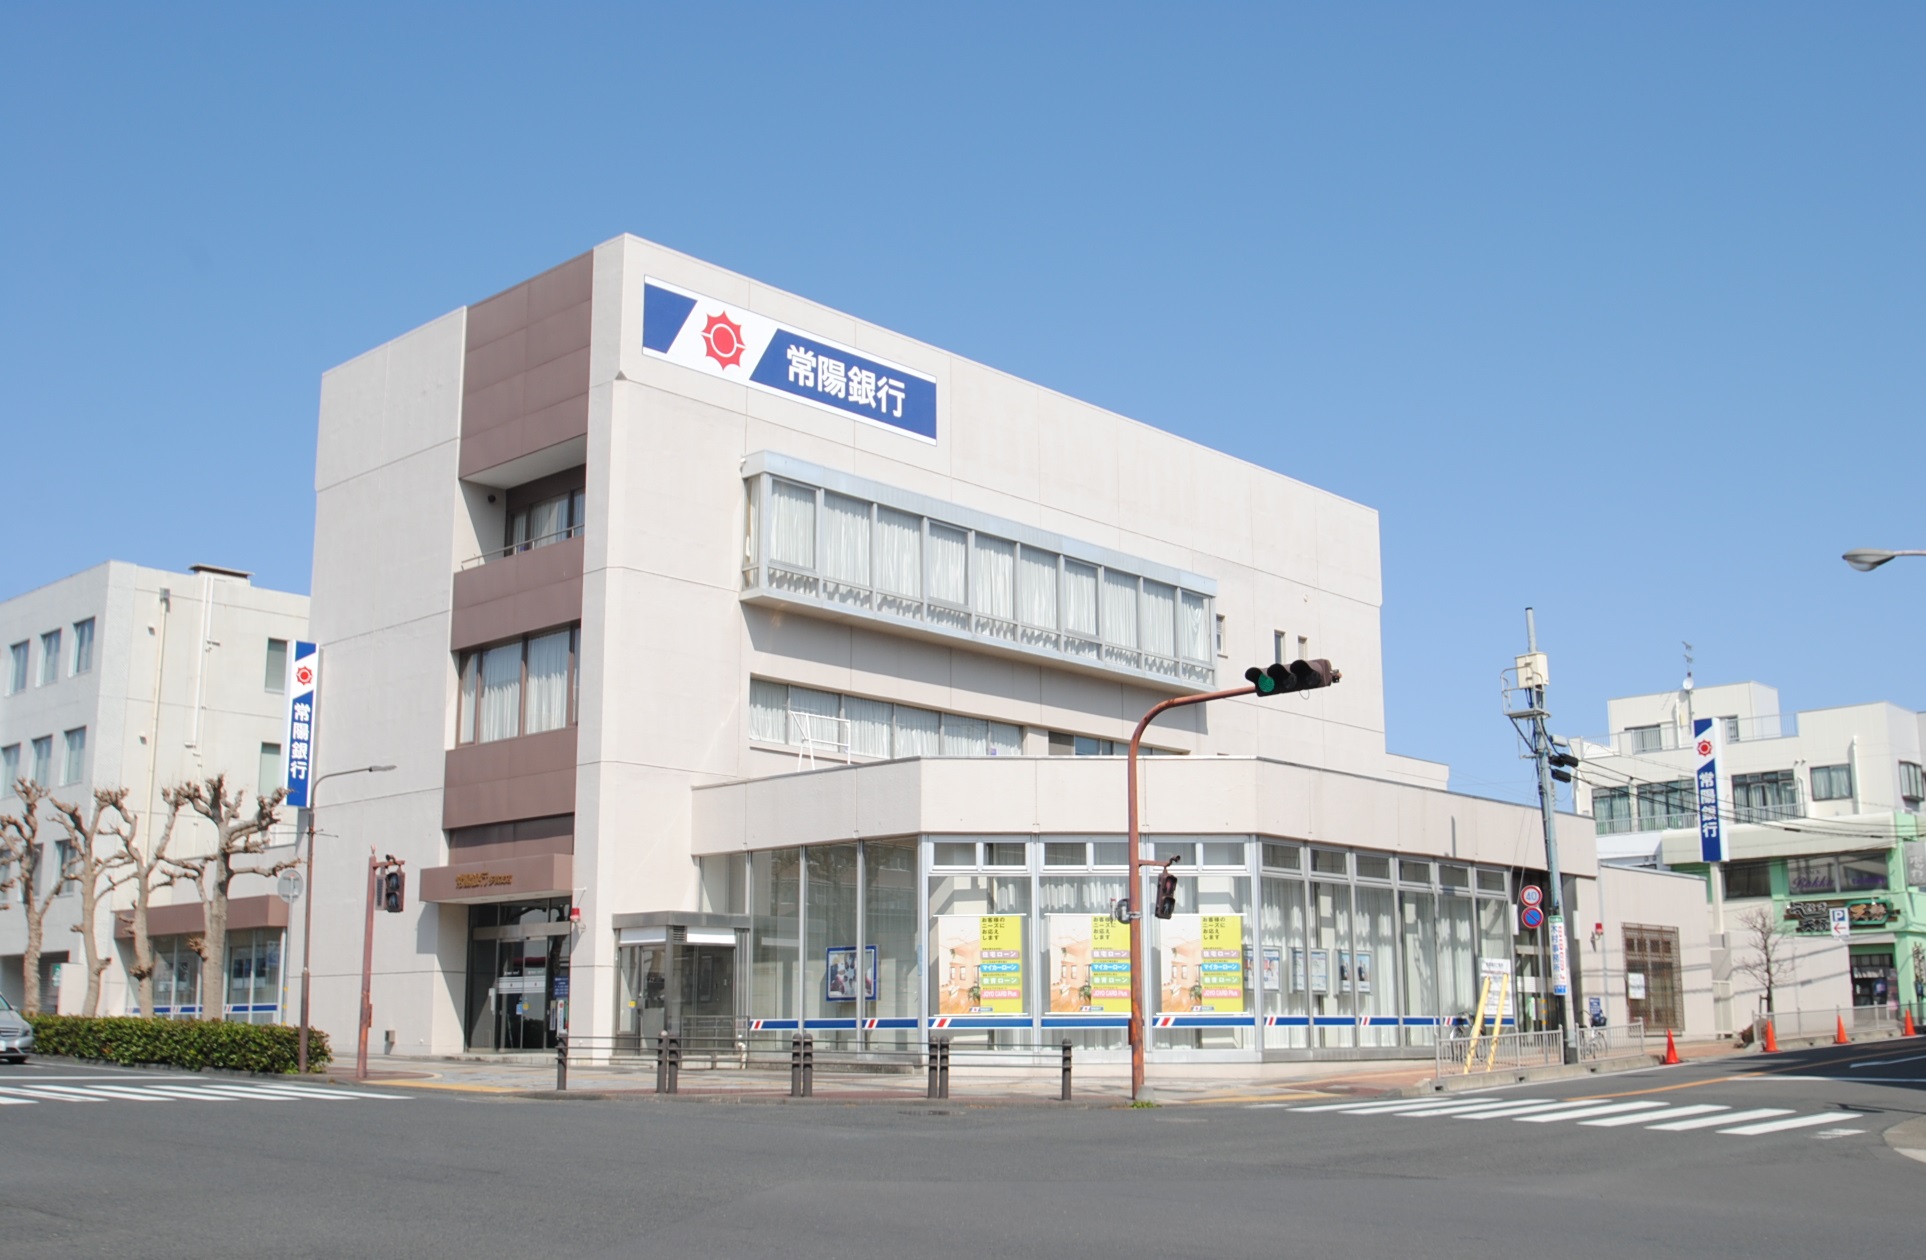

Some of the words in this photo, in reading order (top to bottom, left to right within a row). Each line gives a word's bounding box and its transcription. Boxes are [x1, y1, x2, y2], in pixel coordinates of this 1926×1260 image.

[786, 344, 906, 418] 常陽銀行
[290, 702, 310, 780] 常陽銀行
[1699, 771, 1718, 838] 常陽銀行
[1526, 891, 1537, 901] 40
[1834, 911, 1843, 921] P
[1550, 925, 1560, 972] 木村事務所
